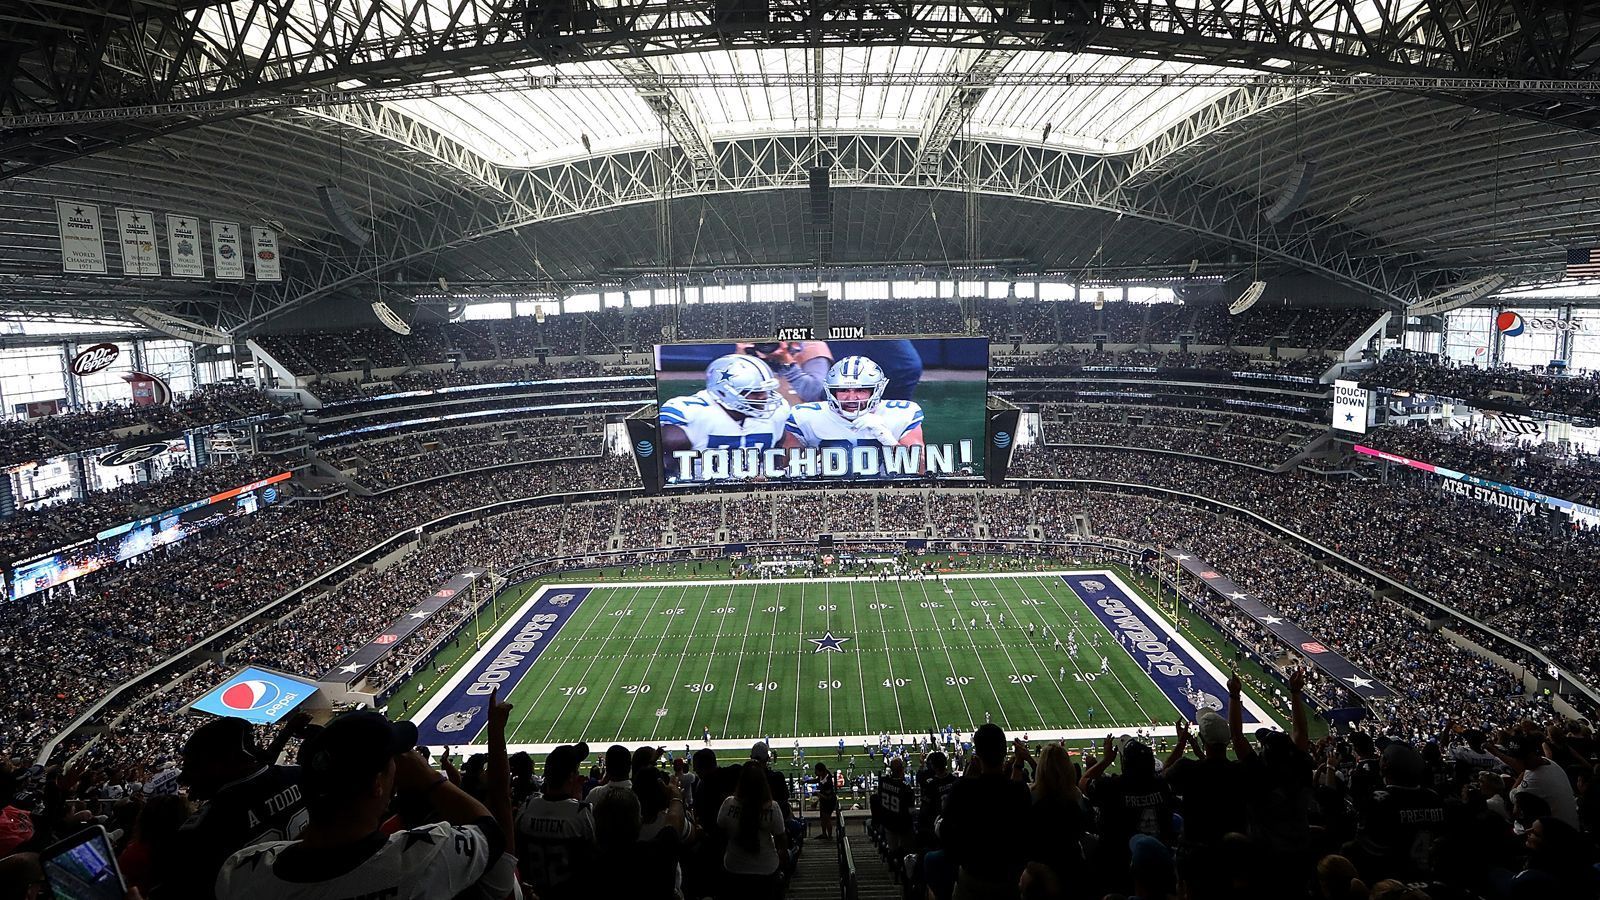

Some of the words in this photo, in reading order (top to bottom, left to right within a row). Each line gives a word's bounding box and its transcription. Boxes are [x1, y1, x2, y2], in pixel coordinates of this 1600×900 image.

[67, 222, 94, 230] COWBOYS
[66, 257, 103, 265] CHAMPIONS
[777, 328, 808, 340] AT&T
[95, 348, 111, 361] Dr
[74, 350, 118, 373] Pepper
[1335, 386, 1367, 398] TOUCH
[1336, 396, 1365, 408] DOWN
[672, 438, 973, 479] TOUCHDOWN!
[1441, 478, 1472, 499] AT&T
[1474, 487, 1537, 517] STADIUM
[920, 601, 939, 609] 30
[1021, 598, 1041, 606] 10
[767, 605, 787, 613] 40
[818, 604, 838, 612] 50
[1097, 597, 1194, 677] COWBOYS
[466, 613, 558, 696] COWBOYS
[945, 676, 970, 686] 30
[1008, 674, 1033, 685] 20
[1072, 671, 1097, 682] 10
[690, 683, 715, 693] 30
[754, 681, 778, 691] 40
[817, 679, 842, 690] 50
[882, 678, 906, 688] 40
[564, 686, 588, 696] 10
[626, 684, 651, 695] 20
[265, 692, 299, 717] pepsi
[881, 792, 900, 813] 29
[1125, 792, 1163, 807] PRESCOTT
[247, 808, 262, 829] A
[264, 784, 303, 817] TODD
[1400, 808, 1445, 824] PRESCOTT
